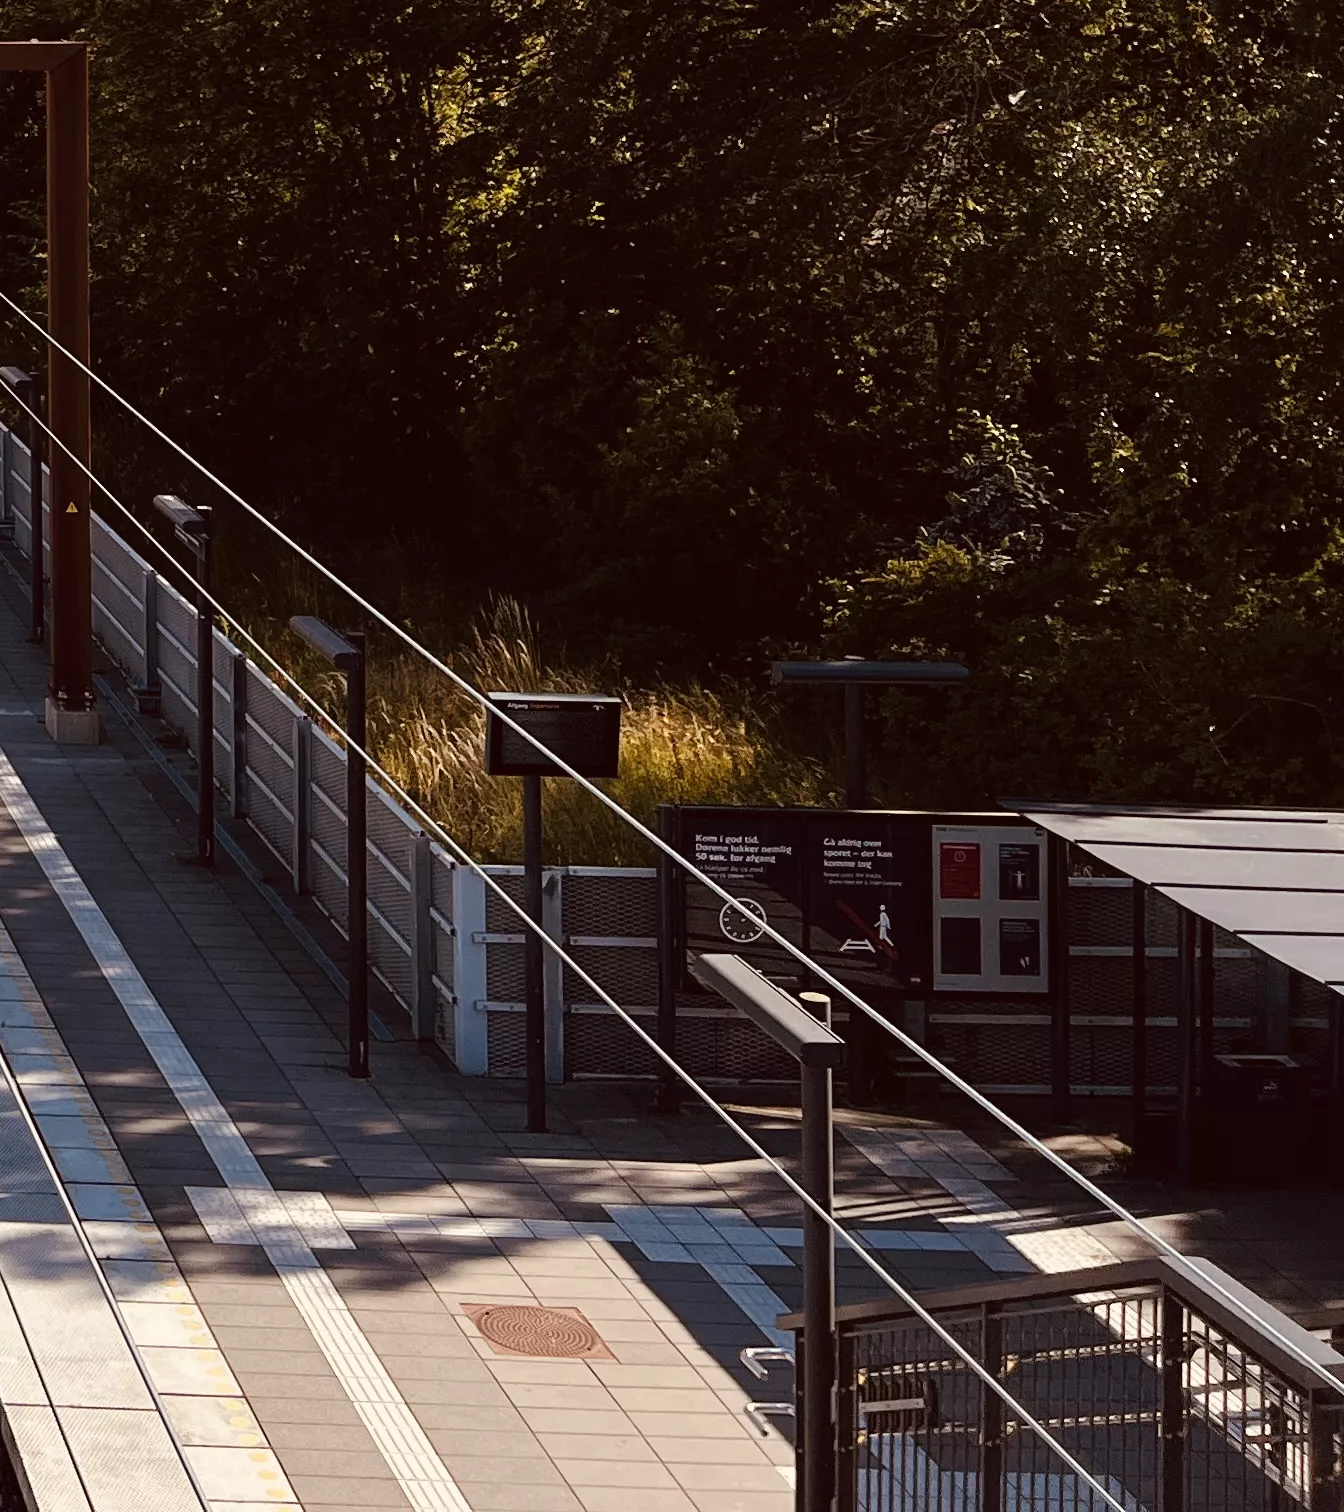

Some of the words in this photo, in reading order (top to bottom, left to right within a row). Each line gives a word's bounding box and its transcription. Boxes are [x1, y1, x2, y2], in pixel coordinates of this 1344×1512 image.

[695, 834, 717, 842] Kom
[725, 836, 743, 844] god
[695, 843, 729, 852] Dørene
[730, 844, 759, 853] lukker
[760, 845, 792, 856] nemlig
[860, 850, 875, 858] der
[876, 849, 893, 857] kan
[745, 854, 776, 864] afgang
[823, 859, 856, 867] komme
